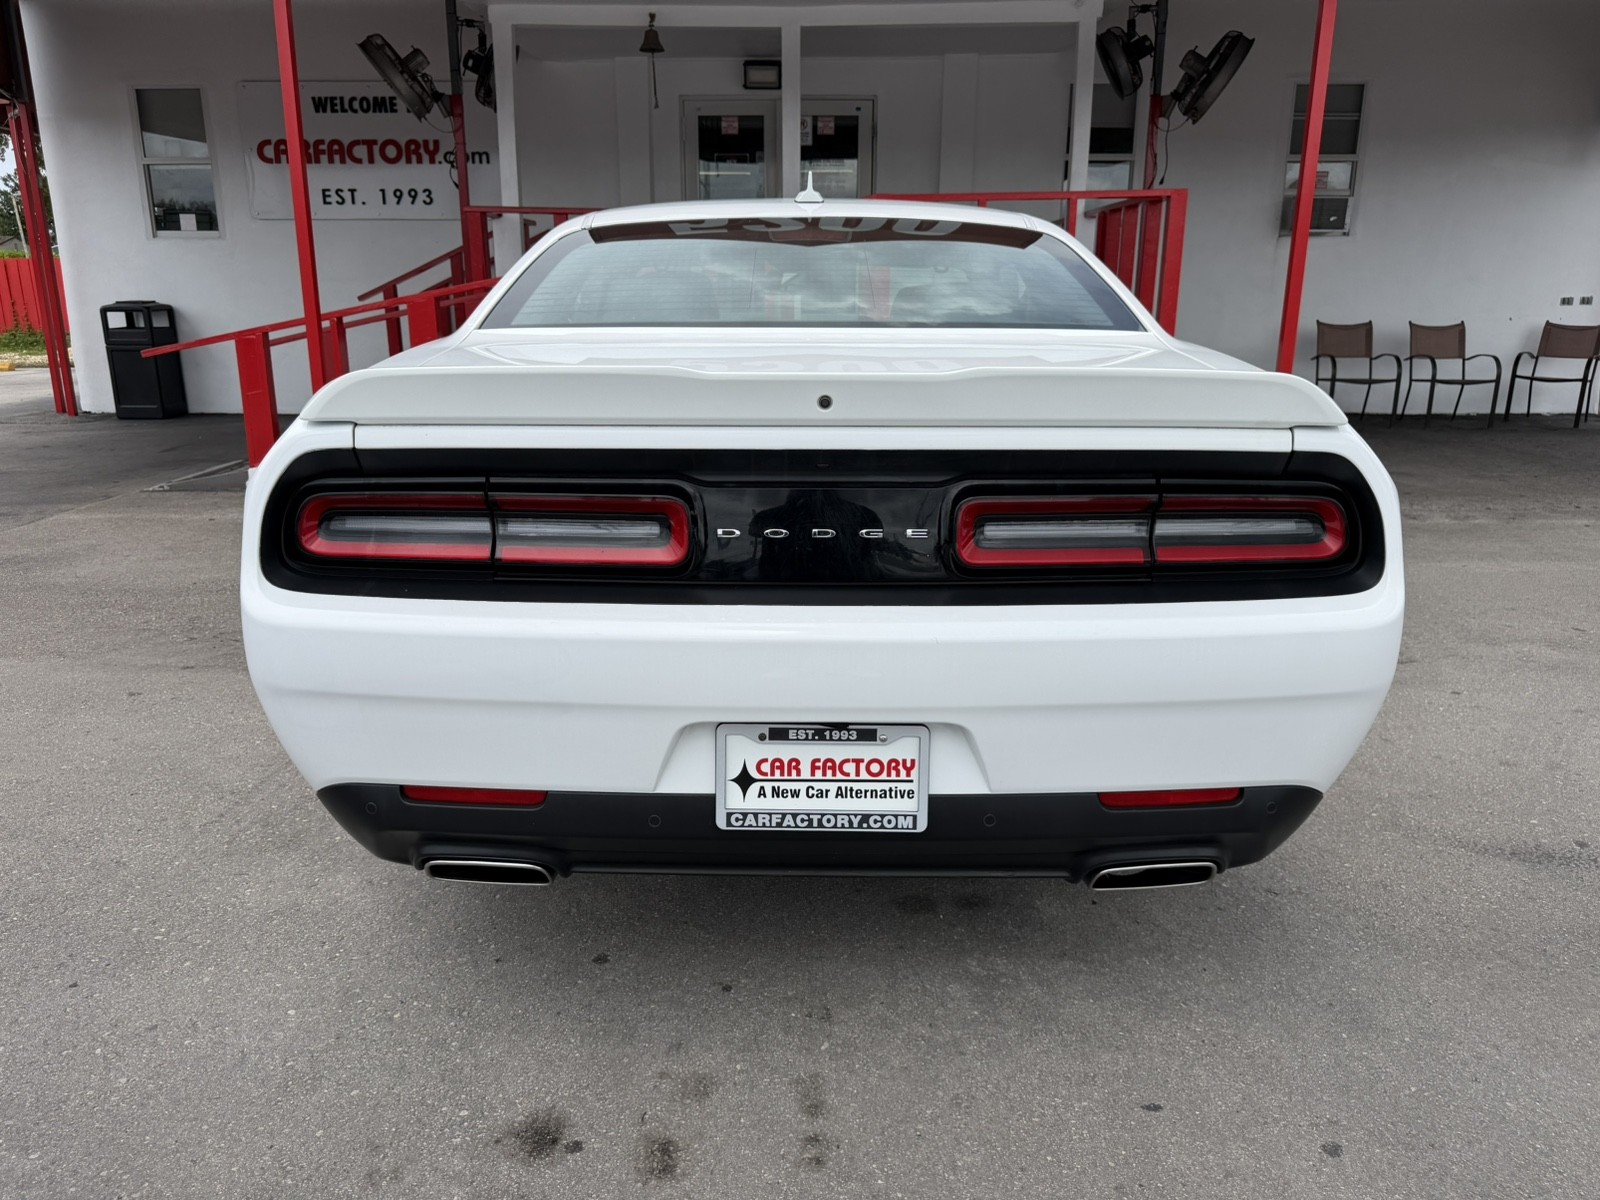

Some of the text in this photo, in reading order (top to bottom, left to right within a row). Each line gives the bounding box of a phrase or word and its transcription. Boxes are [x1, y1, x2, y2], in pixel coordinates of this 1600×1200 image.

[311, 96, 398, 113] WELCOME
[321, 188, 434, 205] EST. 1993
[716, 528, 929, 539] DODGE
[788, 730, 858, 740] EST. 1993
[755, 757, 916, 778] CAR FACTORY
[757, 785, 915, 800] A New Car Alternative
[730, 813, 914, 829] CARFACTORY.COM
